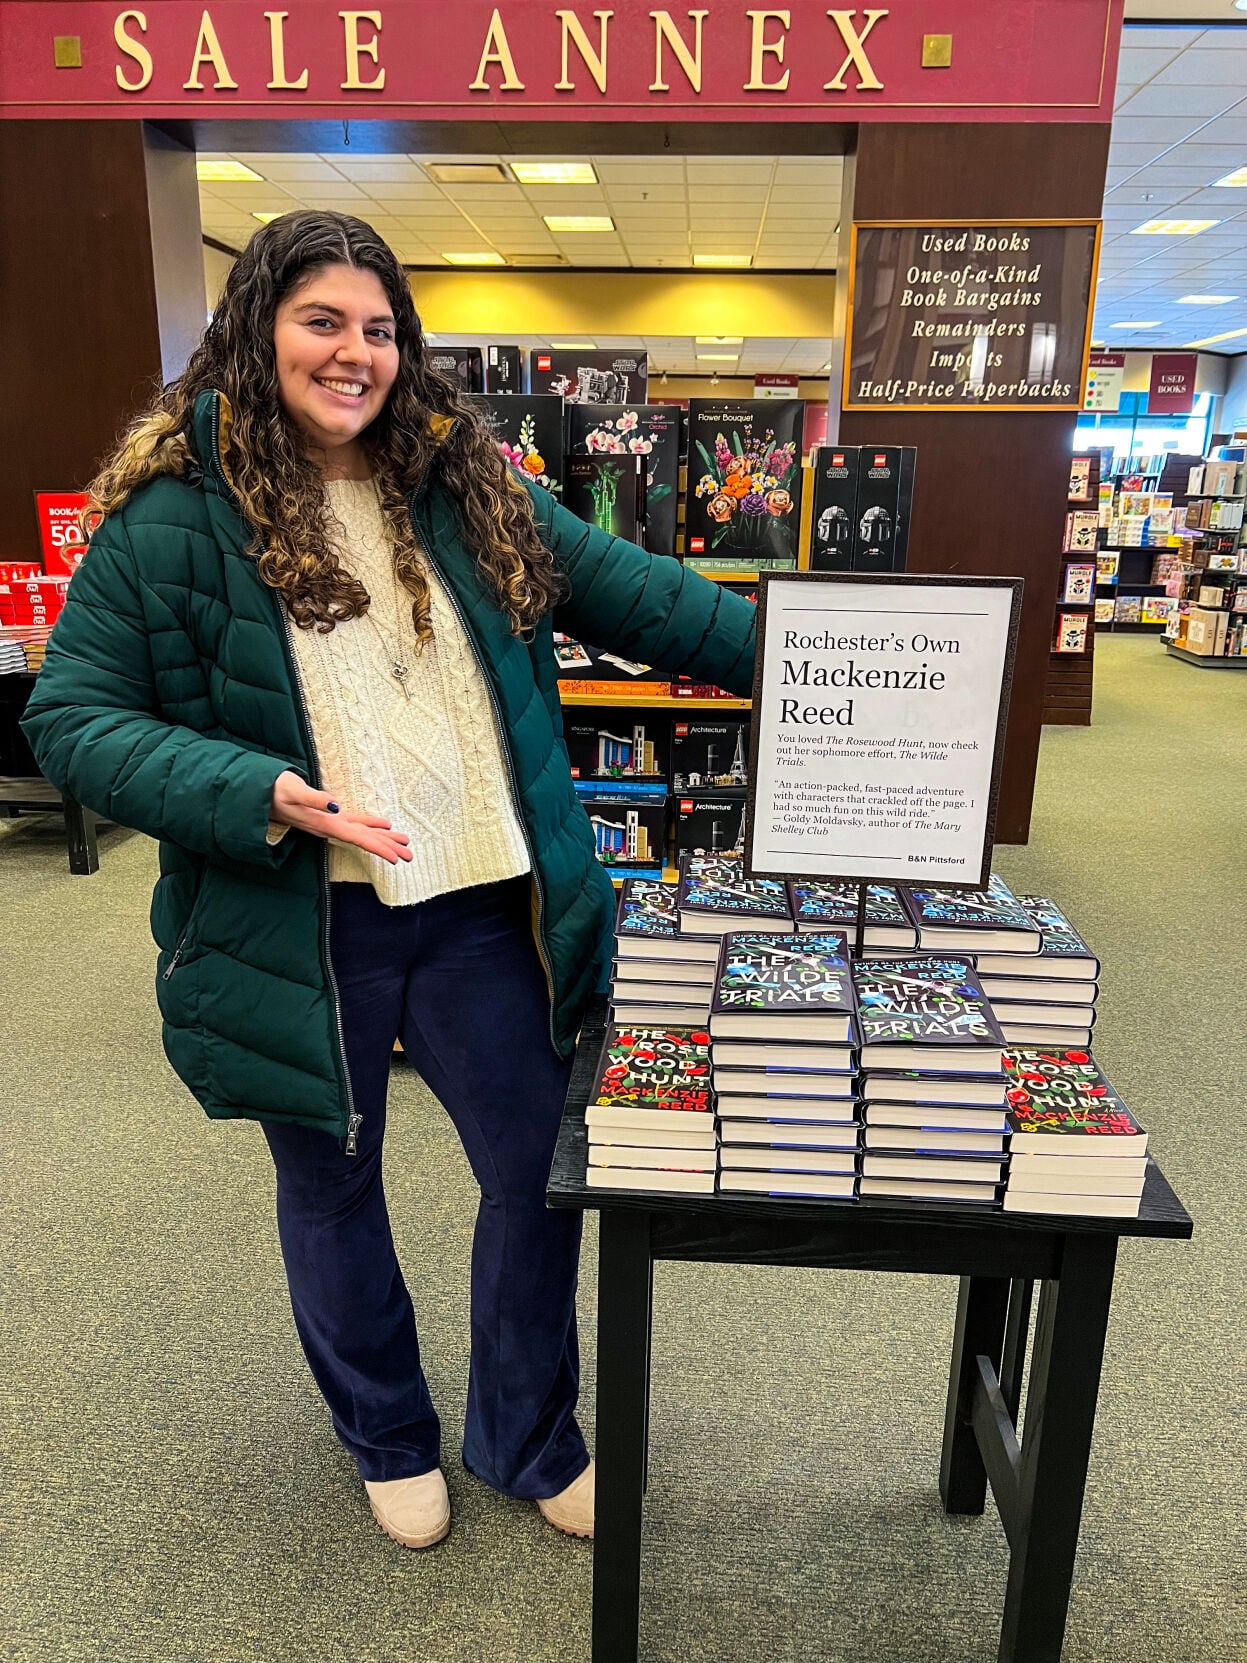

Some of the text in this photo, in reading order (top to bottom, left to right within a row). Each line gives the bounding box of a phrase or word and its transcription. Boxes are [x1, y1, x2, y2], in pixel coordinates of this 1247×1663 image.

[113, 8, 889, 94] SALE ANNEX
[921, 233, 1031, 252] Used Books
[906, 264, 1042, 287] One-of-a-Kind
[900, 288, 1042, 310] Book Bargains
[911, 319, 1026, 338] Remainders
[929, 351, 1003, 372] Impots
[1161, 374, 1185, 384] USED
[857, 380, 1072, 402] Half-Price Paperbacks
[1157, 384, 1187, 394] BOOKS
[698, 414, 754, 424] Flower Bouquet
[783, 630, 961, 654] Rochester’s Own
[780, 660, 946, 690] Mackenzie
[778, 698, 854, 726] Reed
[690, 726, 727, 734] Architecture
[777, 734, 979, 750] You loved The Rosewood Hunt, now check
[776, 746, 948, 760] out her sophomore effort, The Wilde
[776, 756, 806, 767] Trials.
[794, 780, 862, 793] action-packed,
[865, 784, 914, 796] fast-paced
[916, 786, 964, 796] adventure
[695, 803, 732, 812] Architecture
[773, 791, 974, 810] with characters that crackled off the page. I
[773, 802, 790, 811] had
[805, 804, 830, 814] much
[834, 805, 849, 814] fun
[866, 806, 884, 816] this
[886, 808, 906, 817] wild
[770, 824, 829, 836] Shelley Club
[784, 814, 811, 825] Goldy
[813, 816, 866, 828] Moldavsky,
[868, 818, 900, 828] author
[902, 820, 912, 828] of
[914, 820, 932, 830] The
[934, 821, 962, 832] Mary
[929, 856, 965, 864] Pittsford
[734, 882, 784, 896] THE
[728, 956, 785, 966] THE
[854, 963, 964, 972] MACKENZIE
[740, 971, 840, 983] WILDE
[722, 990, 841, 1003] TRIALS
[858, 984, 919, 996] THE
[876, 1001, 981, 1014] WILDE
[614, 1028, 666, 1040] THE
[862, 1020, 989, 1037] TRIALS
[638, 1042, 708, 1056] ROSE
[1001, 1050, 1040, 1061] HE
[608, 1054, 696, 1070] WOOD
[1019, 1063, 1096, 1076] ROSE
[630, 1072, 710, 1086] HUNT
[600, 1085, 708, 1099] MACKENZIE
[658, 1102, 708, 1110] REED
[1032, 1096, 1117, 1108] HUNT
[1014, 1110, 1128, 1121] MACKENZIE
[1084, 1126, 1138, 1134] REED
